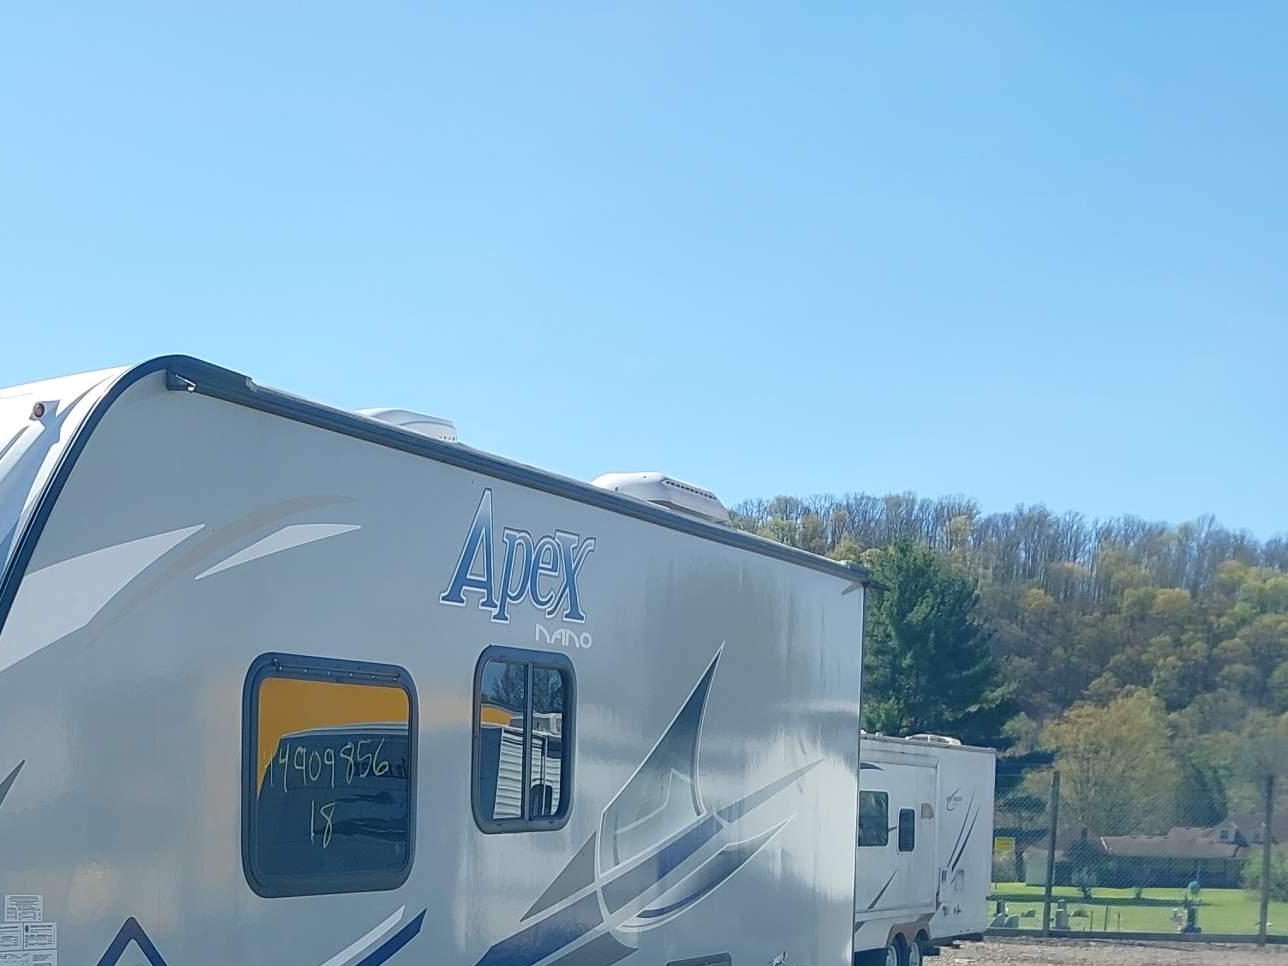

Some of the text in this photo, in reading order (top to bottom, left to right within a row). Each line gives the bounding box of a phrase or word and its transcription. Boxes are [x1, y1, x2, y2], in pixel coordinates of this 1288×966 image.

[440, 487, 596, 624] Apex
[535, 623, 593, 648] NANO
[263, 738, 389, 793] 44909856
[310, 799, 336, 848] 18
